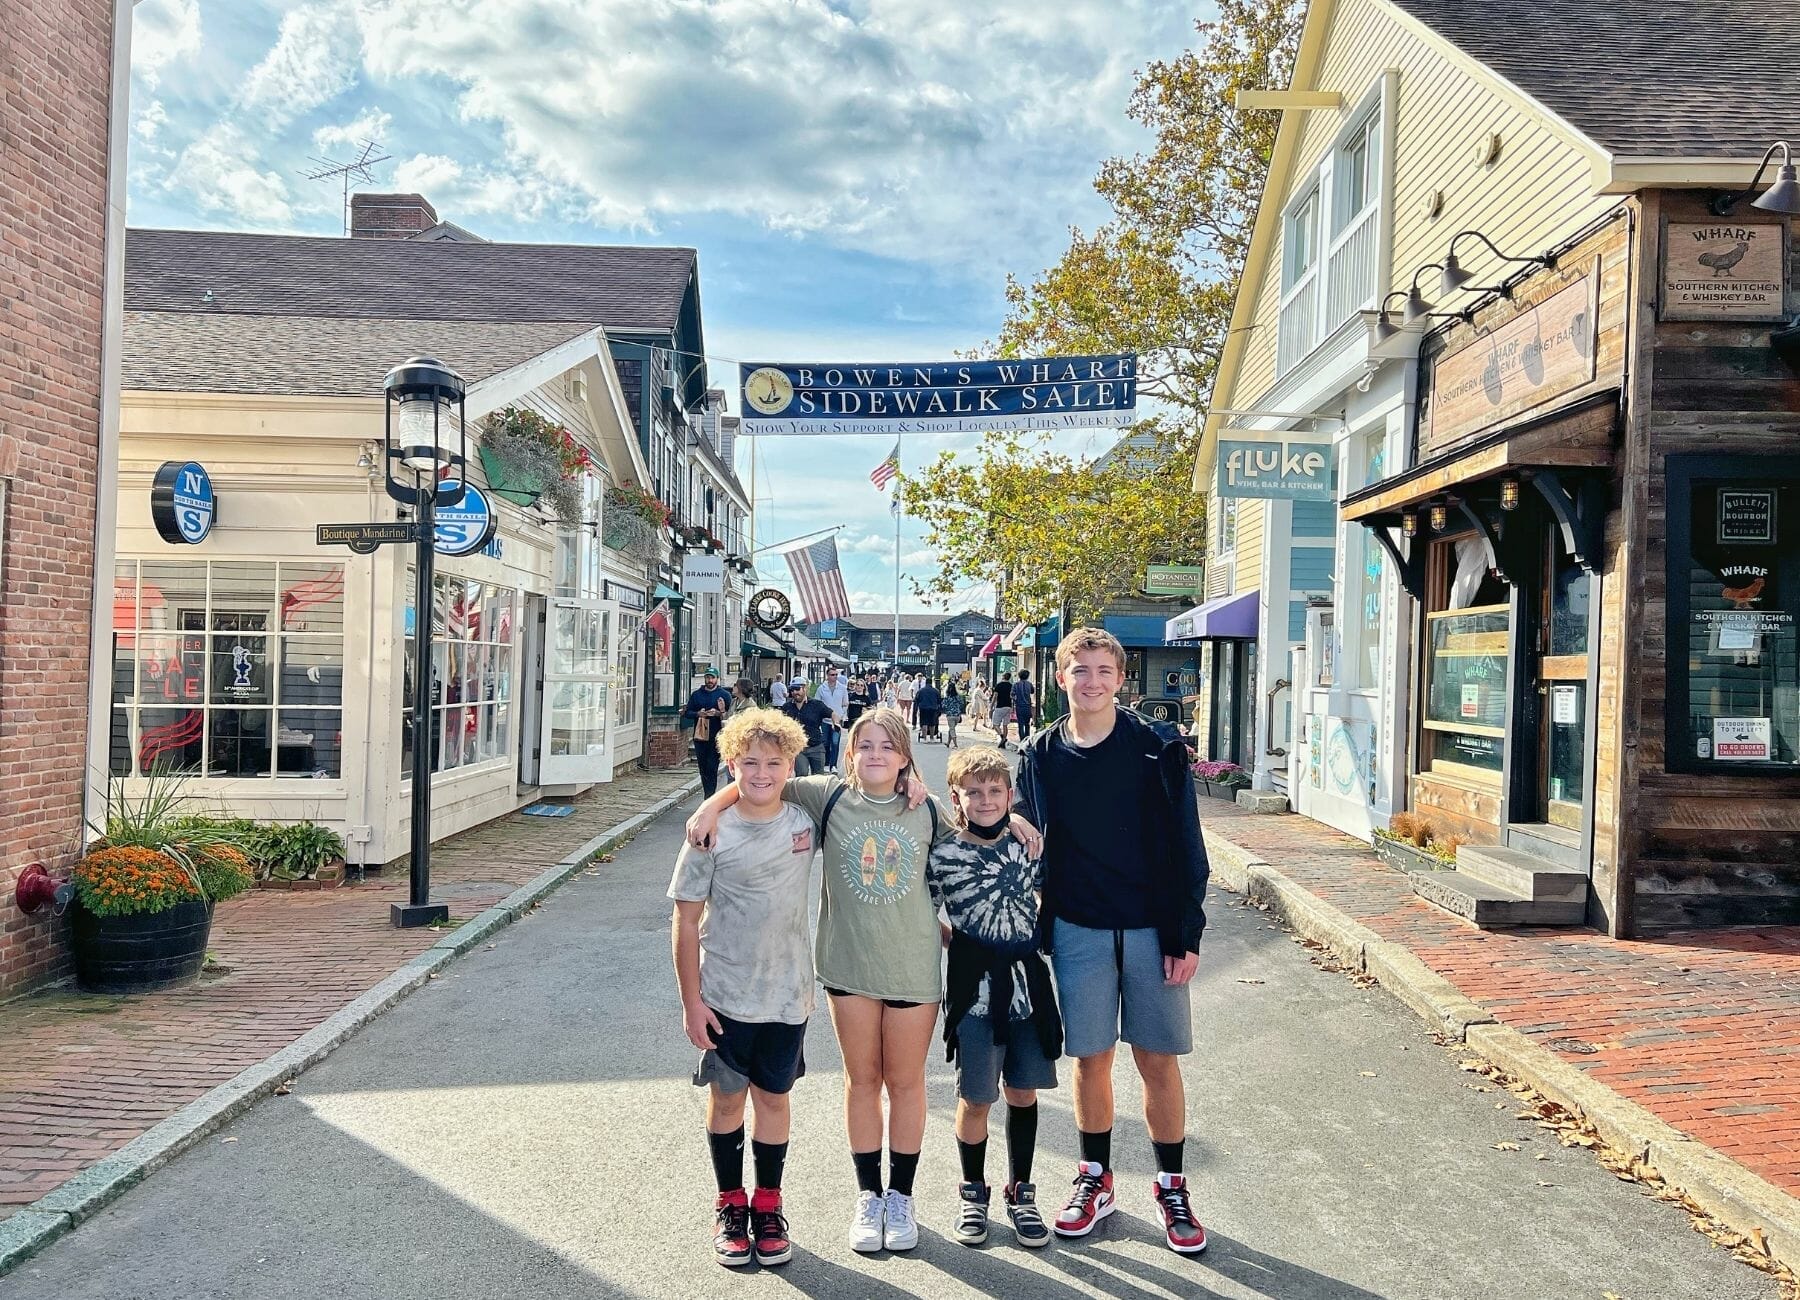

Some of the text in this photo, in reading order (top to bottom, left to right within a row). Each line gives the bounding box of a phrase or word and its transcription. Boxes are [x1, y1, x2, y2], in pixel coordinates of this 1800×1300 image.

[1692, 227, 1758, 242] WHARF
[1668, 283, 1780, 291] SOUTHERN KITCHEN
[1692, 293, 1741, 301] WHISKEY
[1487, 338, 1520, 368] WHARF
[1442, 379, 1480, 403] SOUTHERN
[1479, 360, 1510, 385] KITCHEN
[1518, 335, 1555, 365] WHISKEY
[1556, 326, 1574, 344] BAR
[799, 358, 1132, 387] BOWEN'S WHARF
[800, 390, 1001, 414] SIDEWALK
[1022, 382, 1128, 410] SALE!
[745, 414, 1132, 434] SHOW YOUR SUPPORT & SHOP LOCALLY THIS WEEKEND
[1226, 442, 1325, 486] fluke
[184, 470, 204, 496] N
[1261, 481, 1279, 489] BAR
[1280, 481, 1287, 489] &
[1287, 481, 1324, 490] KITCHEN
[175, 495, 194, 504] NORTH
[1726, 498, 1767, 509] BULLEIT
[183, 510, 202, 533] S
[322, 527, 406, 541] Boutique Mandarine
[435, 524, 467, 543] S
[685, 570, 720, 579] BRAHMIN
[1151, 573, 1199, 581] BOTANICAL
[1720, 565, 1768, 577] WHARF
[1695, 613, 1793, 622] SOUTHERN KITCHEN
[1715, 622, 1759, 630] WHISKEY
[1464, 665, 1488, 680] WHARF
[840, 826, 863, 851] ISLAND
[863, 820, 887, 830] STYLE
[890, 823, 908, 836] SURF
